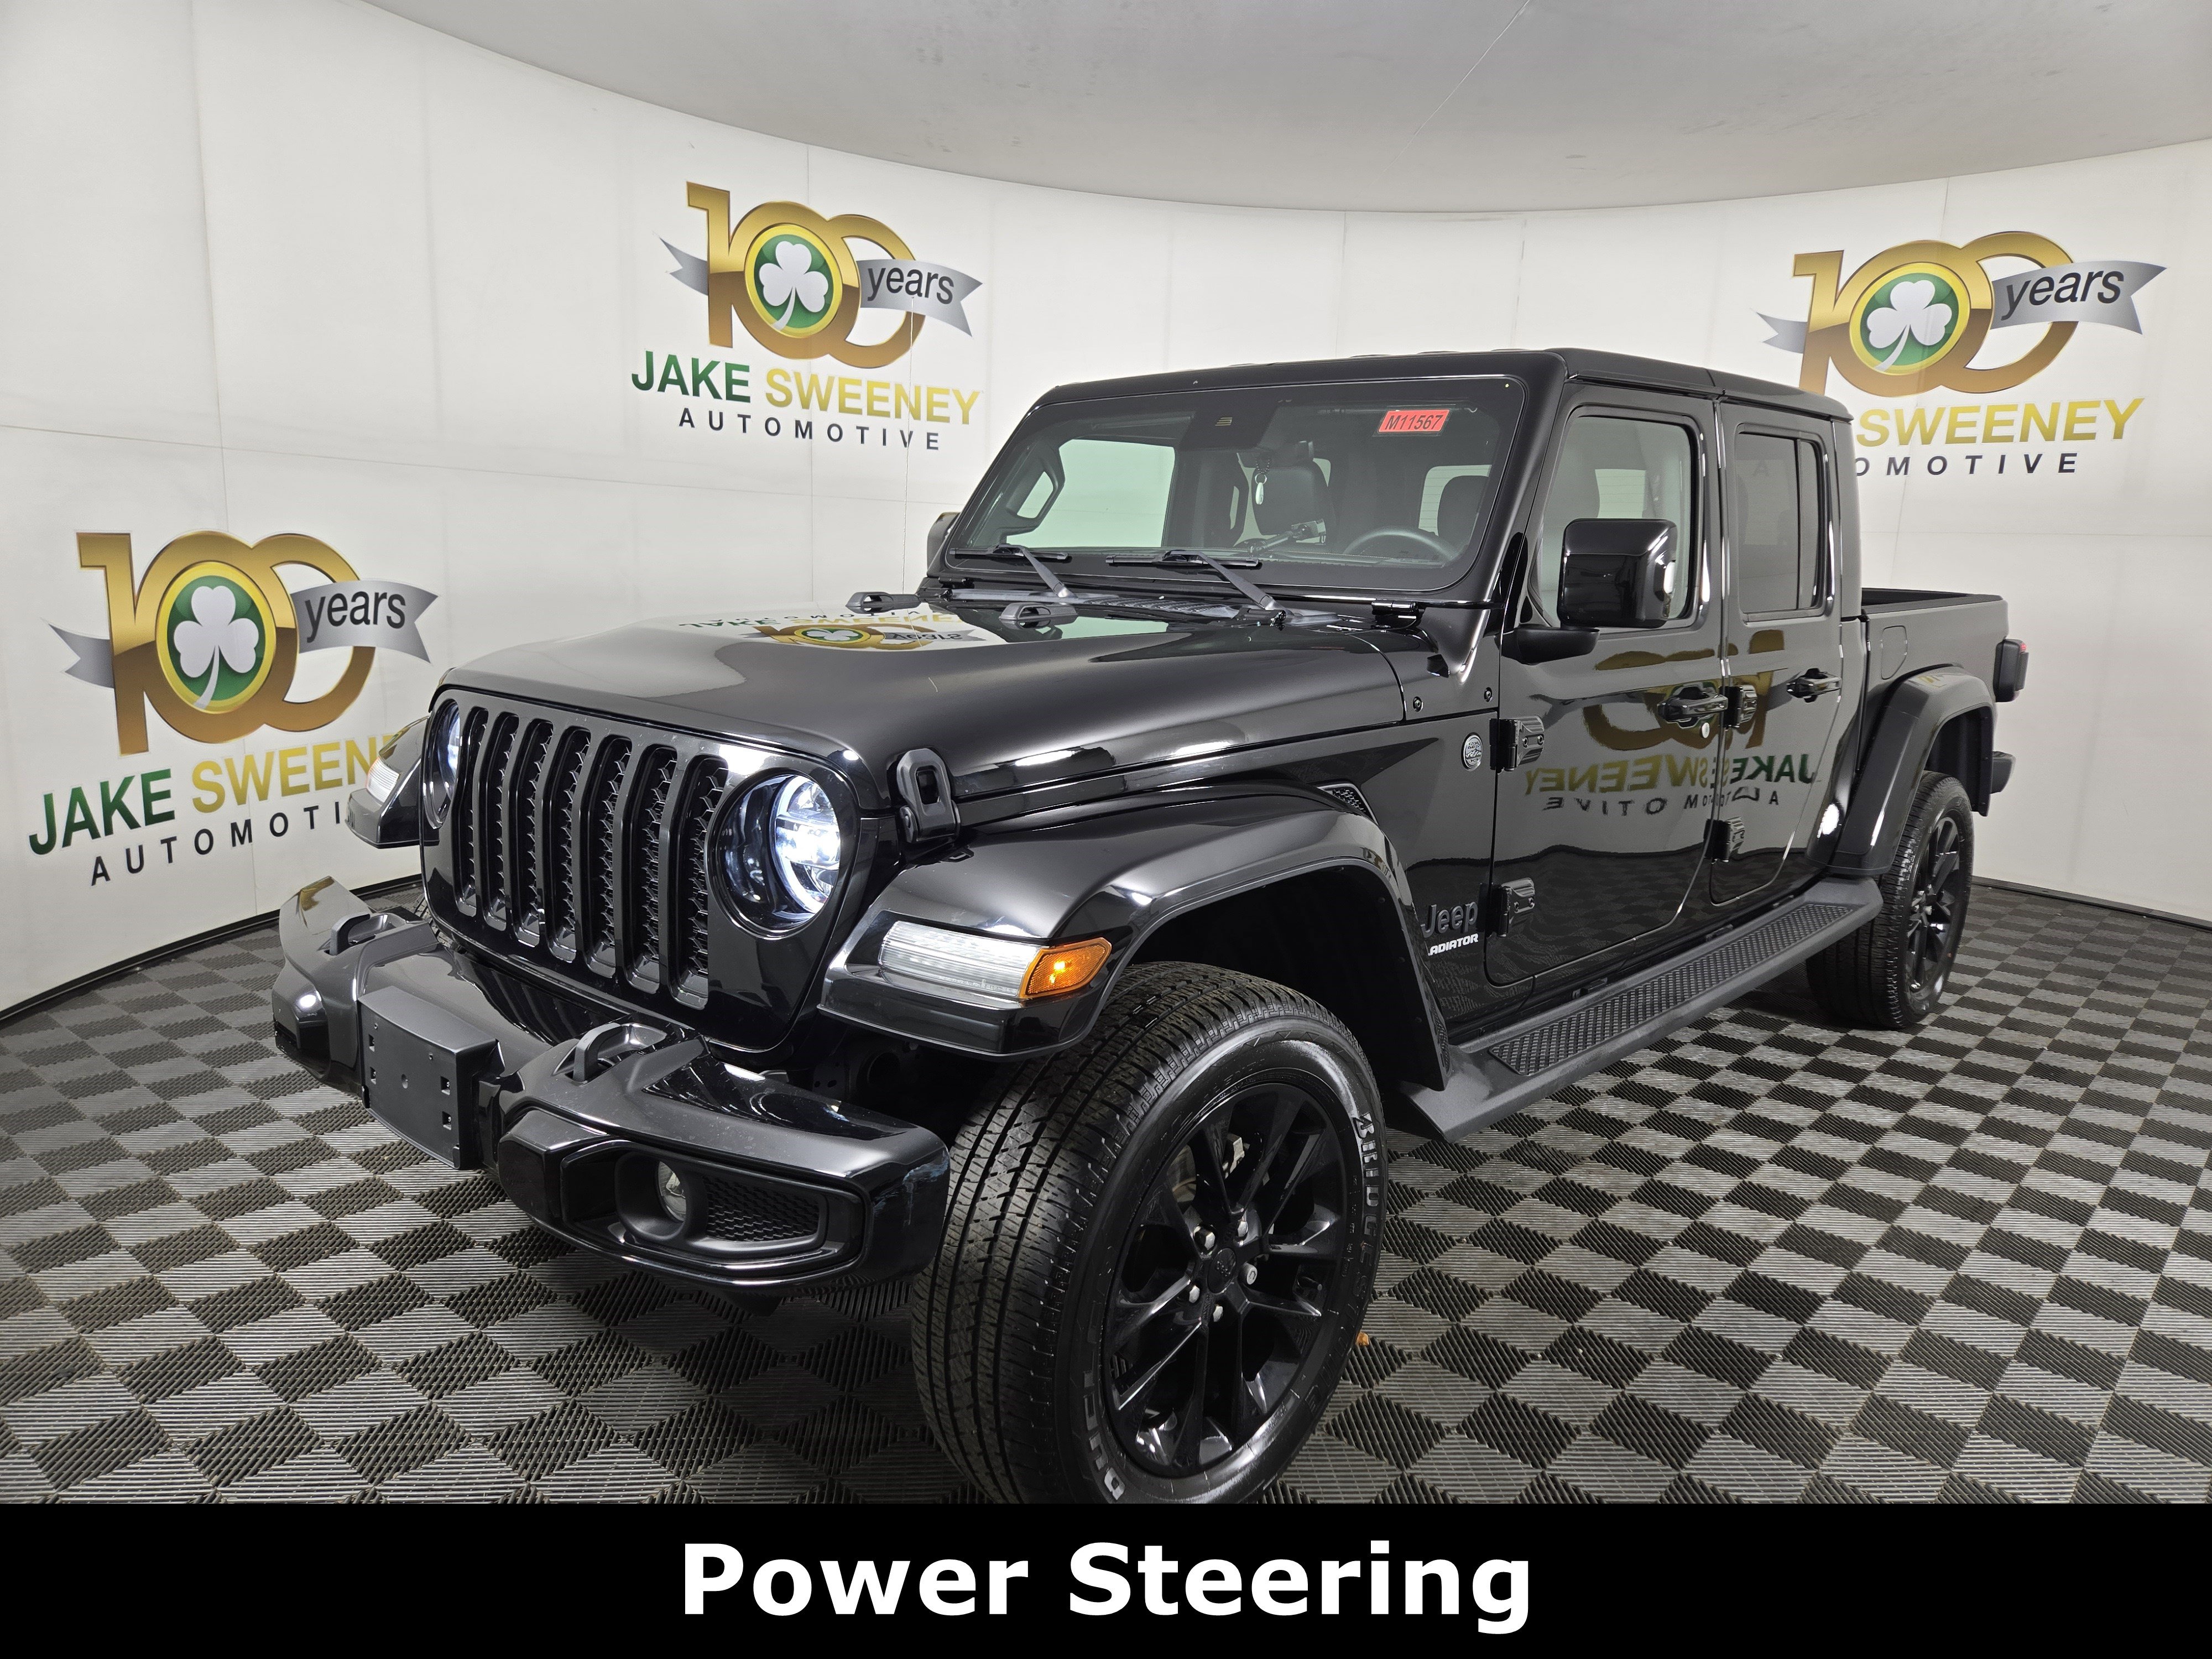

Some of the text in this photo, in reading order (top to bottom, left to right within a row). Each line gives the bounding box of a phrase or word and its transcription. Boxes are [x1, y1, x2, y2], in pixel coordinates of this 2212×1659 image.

[867, 267, 954, 304] years
[2000, 270, 2124, 321] years
[632, 351, 979, 424] JAKE SWEENEY
[679, 408, 938, 450] AUTOMOTIVE
[1385, 415, 1444, 430] M11567
[1856, 398, 2143, 446] SWEENEY
[1855, 453, 2078, 476] OMOTIVE
[304, 591, 406, 644] years
[29, 734, 394, 854] JAKE SWEEN
[91, 801, 340, 886] AUTOMOTI
[1420, 901, 1478, 938] Jeep
[1428, 933, 1479, 956] ADIATOR
